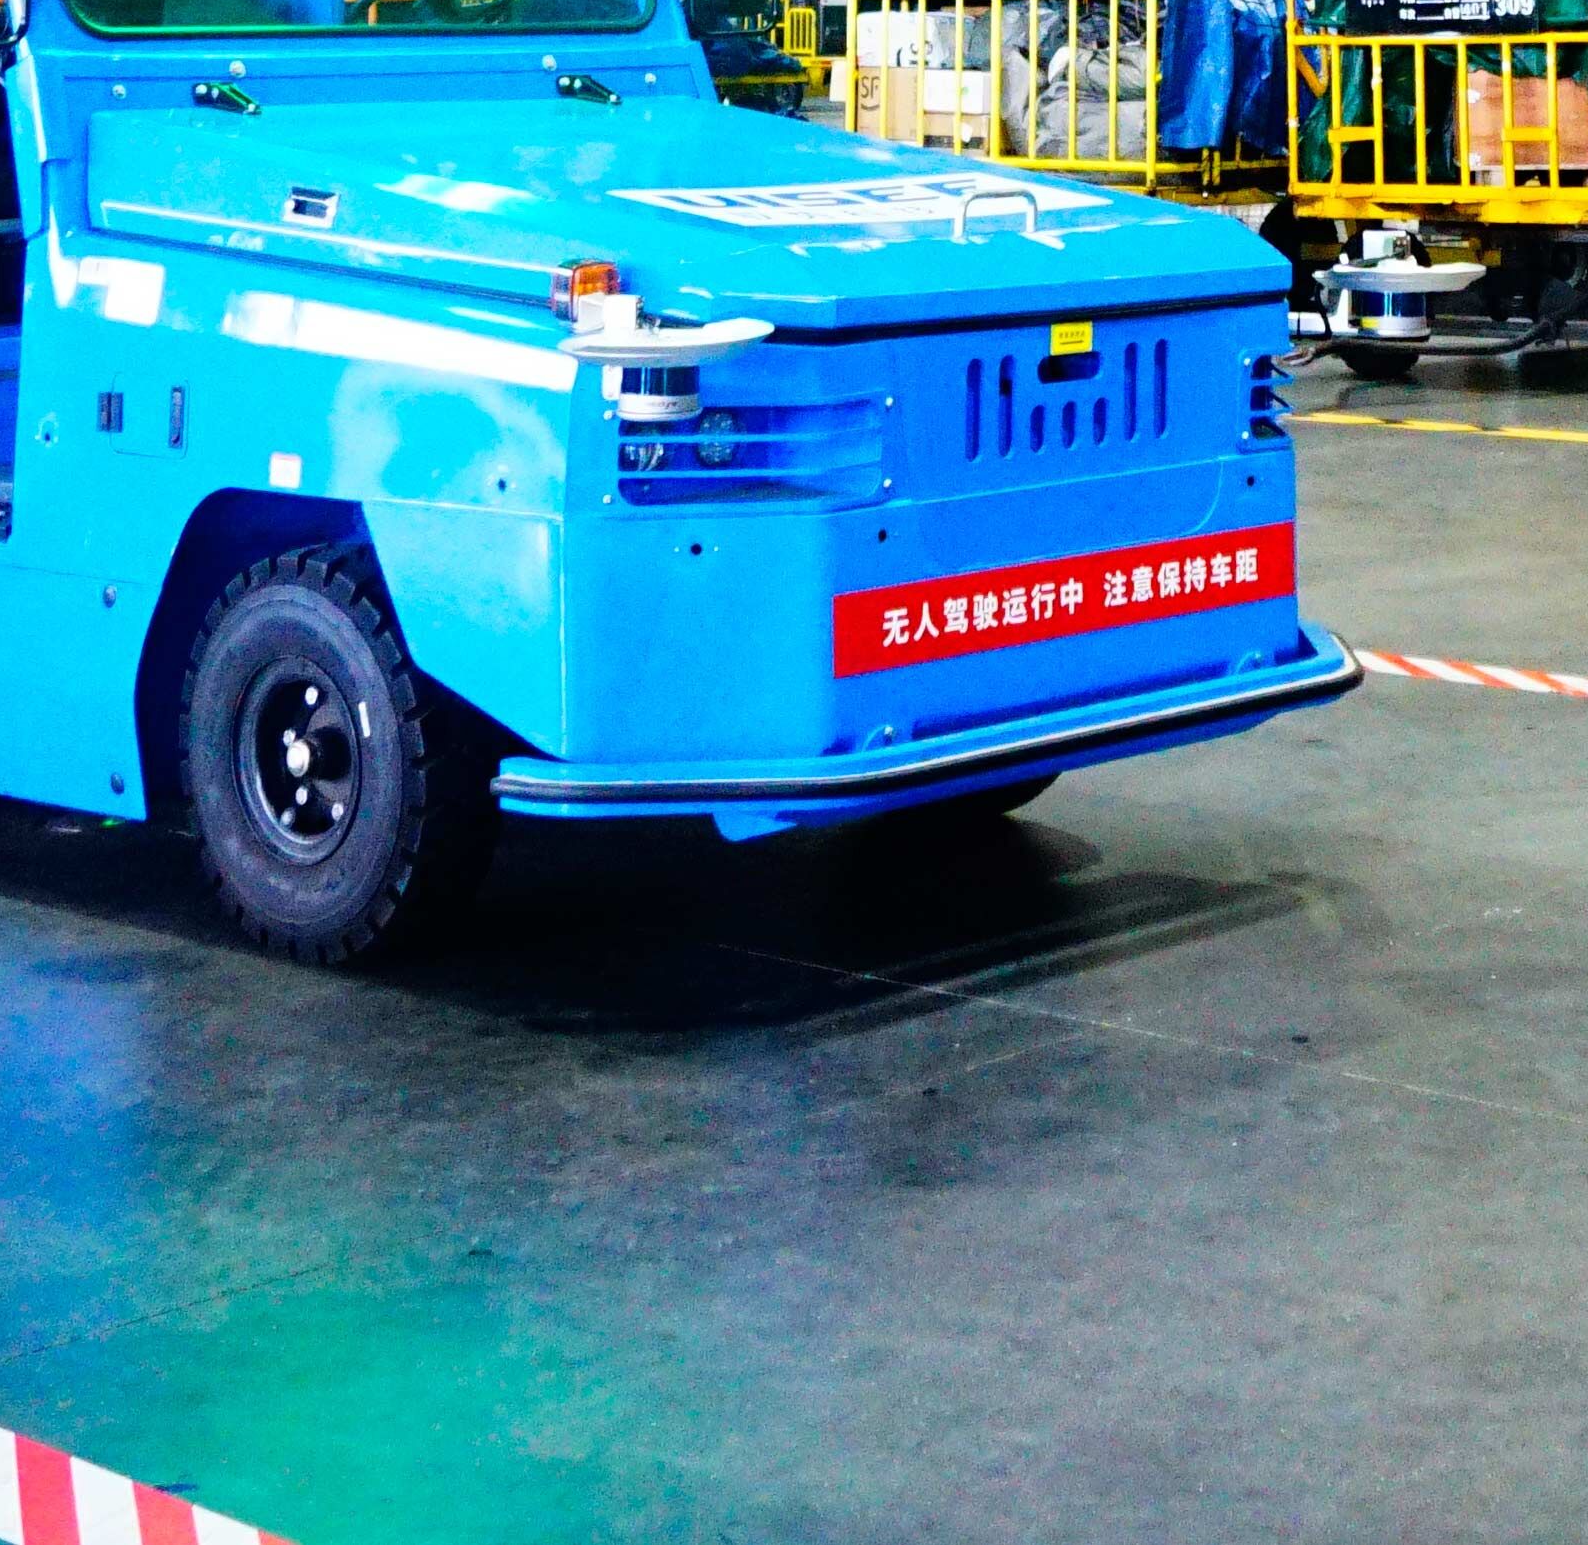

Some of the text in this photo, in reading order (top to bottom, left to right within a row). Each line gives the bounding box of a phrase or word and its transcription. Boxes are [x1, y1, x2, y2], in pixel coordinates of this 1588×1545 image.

[882, 548, 1259, 648] 无人驾驶运行中 注意保持车距
